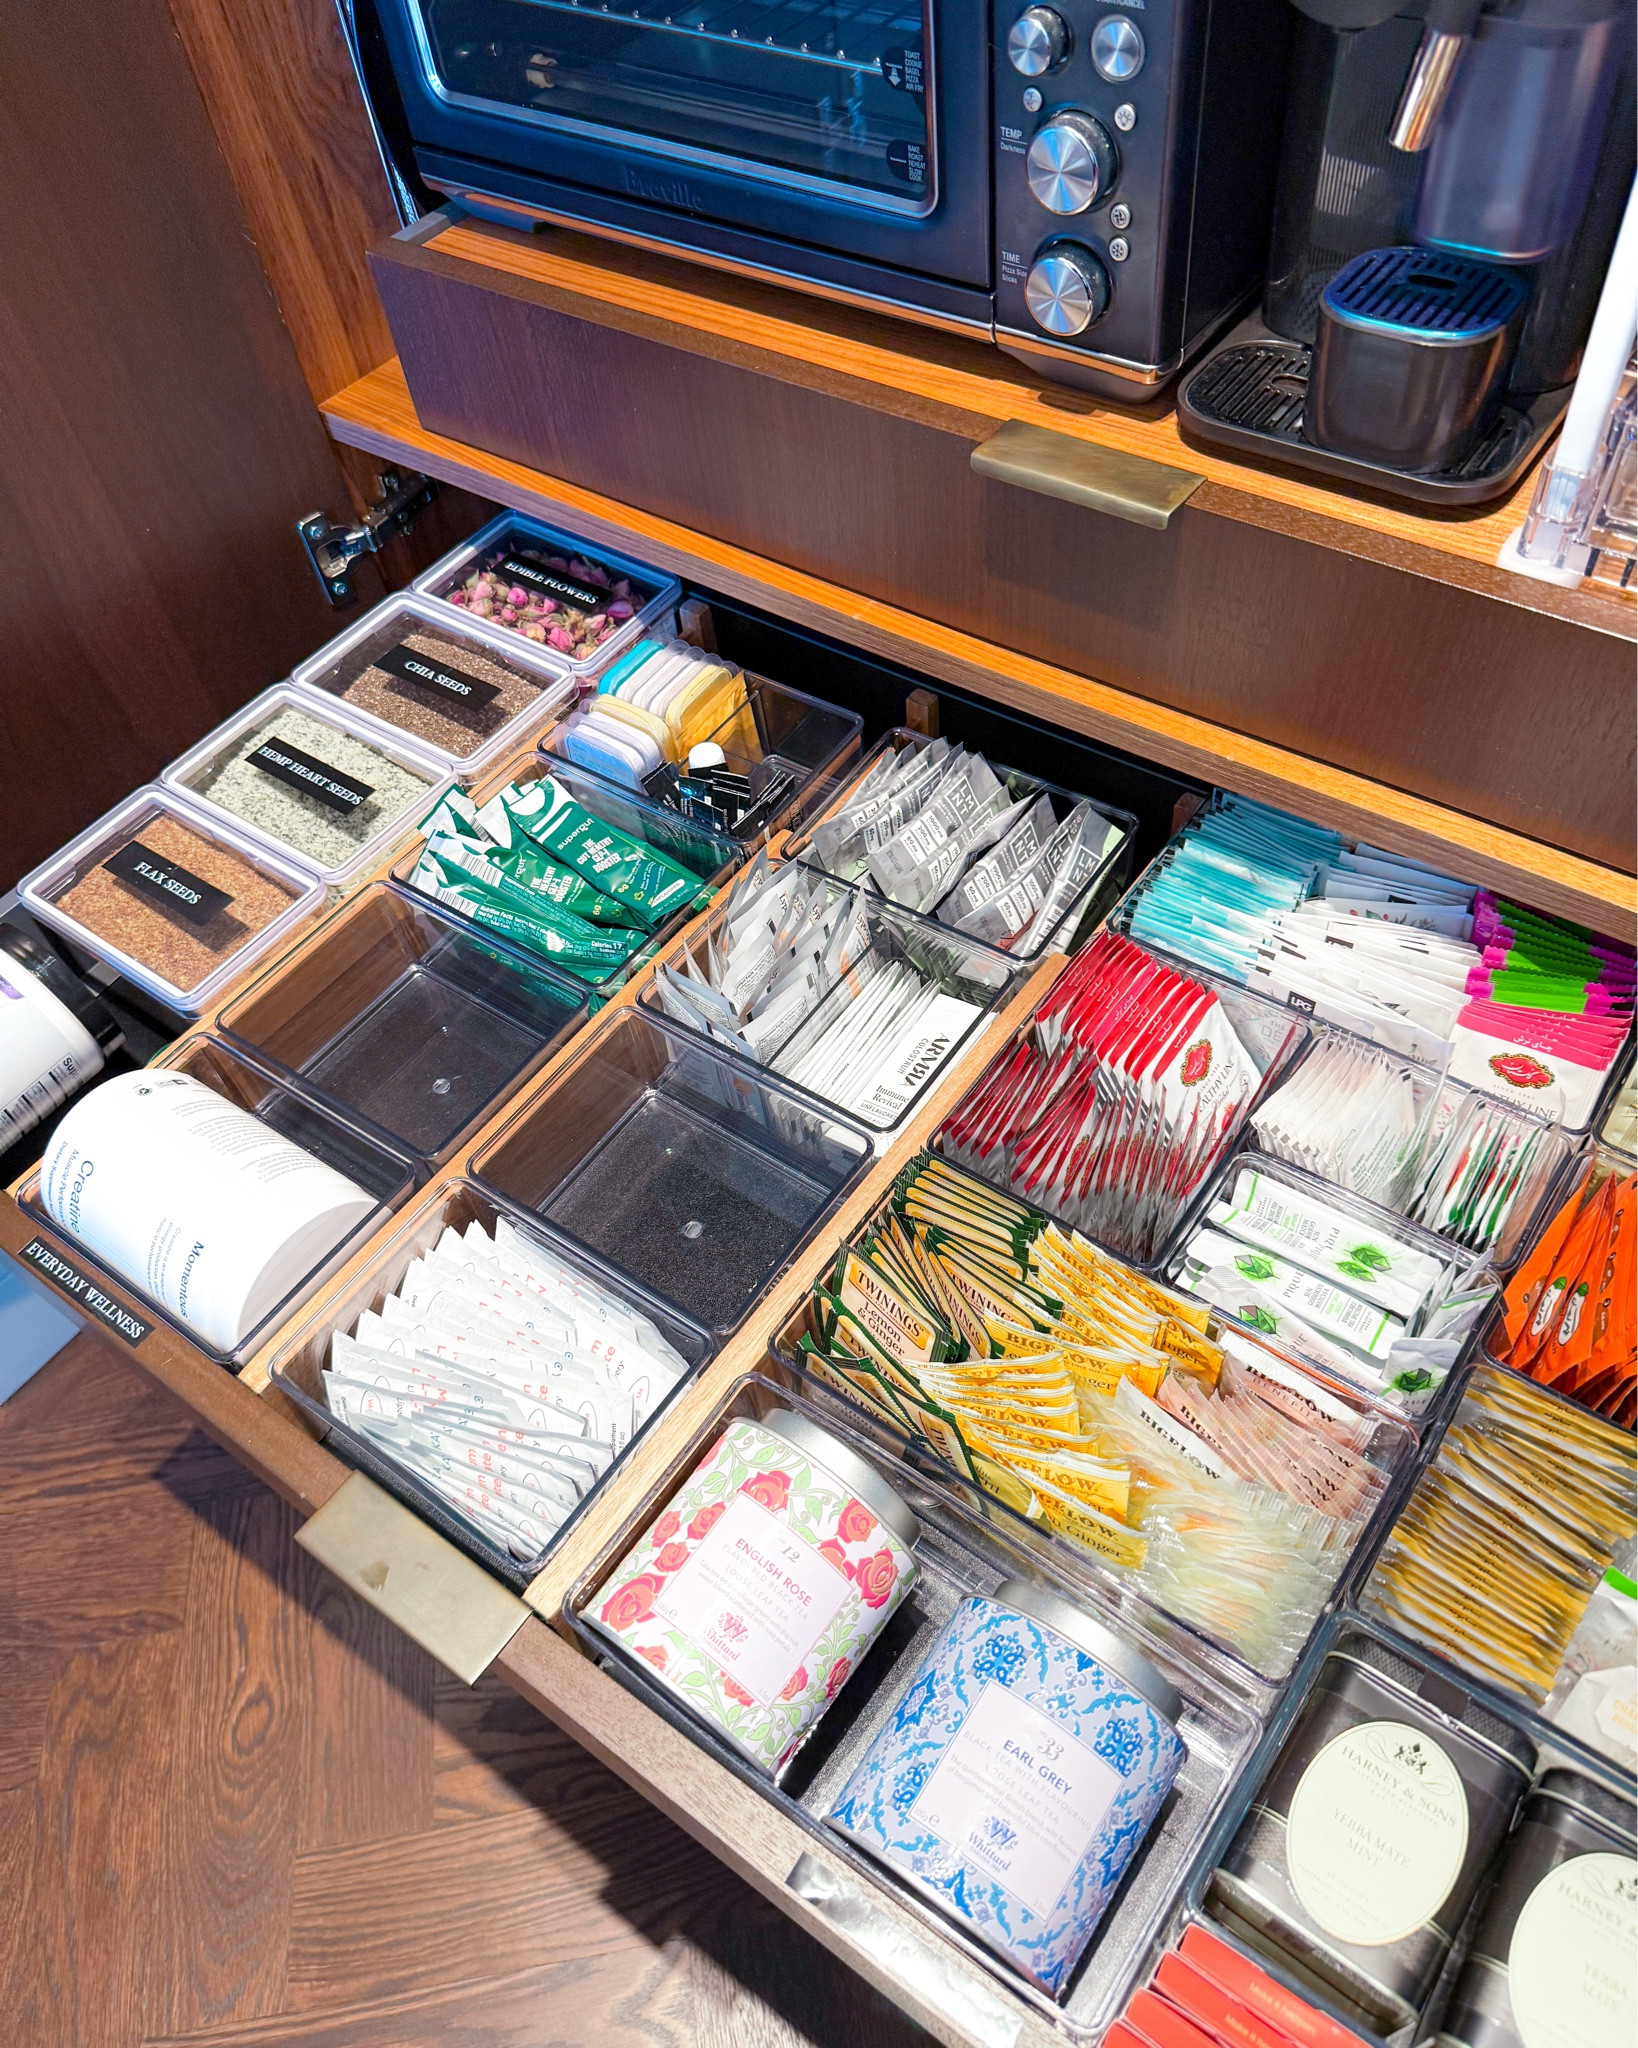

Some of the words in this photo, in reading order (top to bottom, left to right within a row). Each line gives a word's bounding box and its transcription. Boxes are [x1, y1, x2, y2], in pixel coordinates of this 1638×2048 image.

[904, 50, 920, 60] TOAST
[1000, 126, 1023, 139] TEMP
[1000, 142, 1026, 155] Darkness
[1002, 251, 1021, 264] TIME
[504, 560, 547, 583] EDIBLE
[543, 576, 599, 604] FLOWERS
[403, 660, 436, 680] CHIA
[433, 673, 472, 696] SEEDS
[257, 745, 293, 767] HEMP
[289, 762, 331, 787] HEART
[324, 782, 364, 806] SEEDS
[557, 817, 595, 850] supergut
[576, 851, 592, 865] GUT
[587, 836, 614, 855] HEALTHY
[581, 838, 596, 849] THE
[591, 848, 611, 863] GLP-1
[592, 852, 622, 873] BOOSTER
[132, 861, 169, 885] FLAX
[162, 879, 202, 905] SEEDS
[553, 875, 573, 903] BOOSTER
[1290, 996, 1314, 1013] LPG
[897, 1037, 929, 1074] COLOSTRUM
[872, 1093, 903, 1110] Revival
[875, 1085, 910, 1103] Immune
[61, 1149, 80, 1182] Muscle
[70, 1160, 95, 1234] Creatine
[26, 1241, 90, 1293] EVERYDAY
[84, 1286, 145, 1338] WELLNESS
[179, 1240, 205, 1319] Momentous
[858, 1270, 921, 1338] TWININGS
[864, 1301, 901, 1342] Lemon
[857, 1307, 866, 1321] &
[868, 1317, 905, 1356] Ginger
[1140, 1409, 1220, 1480] BIGELOW
[735, 1537, 784, 1581] ENGLISH
[780, 1545, 801, 1564] 12
[1066, 1524, 1123, 1558] Ginger
[725, 1564, 753, 1590] LOOSE
[752, 1586, 774, 1610] LEAF
[773, 1607, 790, 1623] TEA
[768, 1580, 793, 1608] BLACK
[793, 1604, 810, 1622] TEA
[782, 1577, 813, 1608] ROSE
[1003, 1739, 1035, 1769] EARL
[1038, 1765, 1073, 1796] GREY
[1037, 1737, 1065, 1762] 33
[963, 1729, 992, 1753] BLACK
[994, 1750, 1014, 1768] TEA
[1014, 1765, 1040, 1788] WITH
[1040, 1784, 1093, 1832] FLAVOURING
[984, 1762, 1017, 1791] LOOSE
[1017, 1787, 1041, 1808] LEAF
[1043, 1806, 1060, 1825] TEA
[1342, 1744, 1402, 1790] HARNEY
[1402, 1786, 1415, 1801] &
[1419, 1796, 1458, 1829] SONS
[968, 1831, 1013, 1872] Whittard
